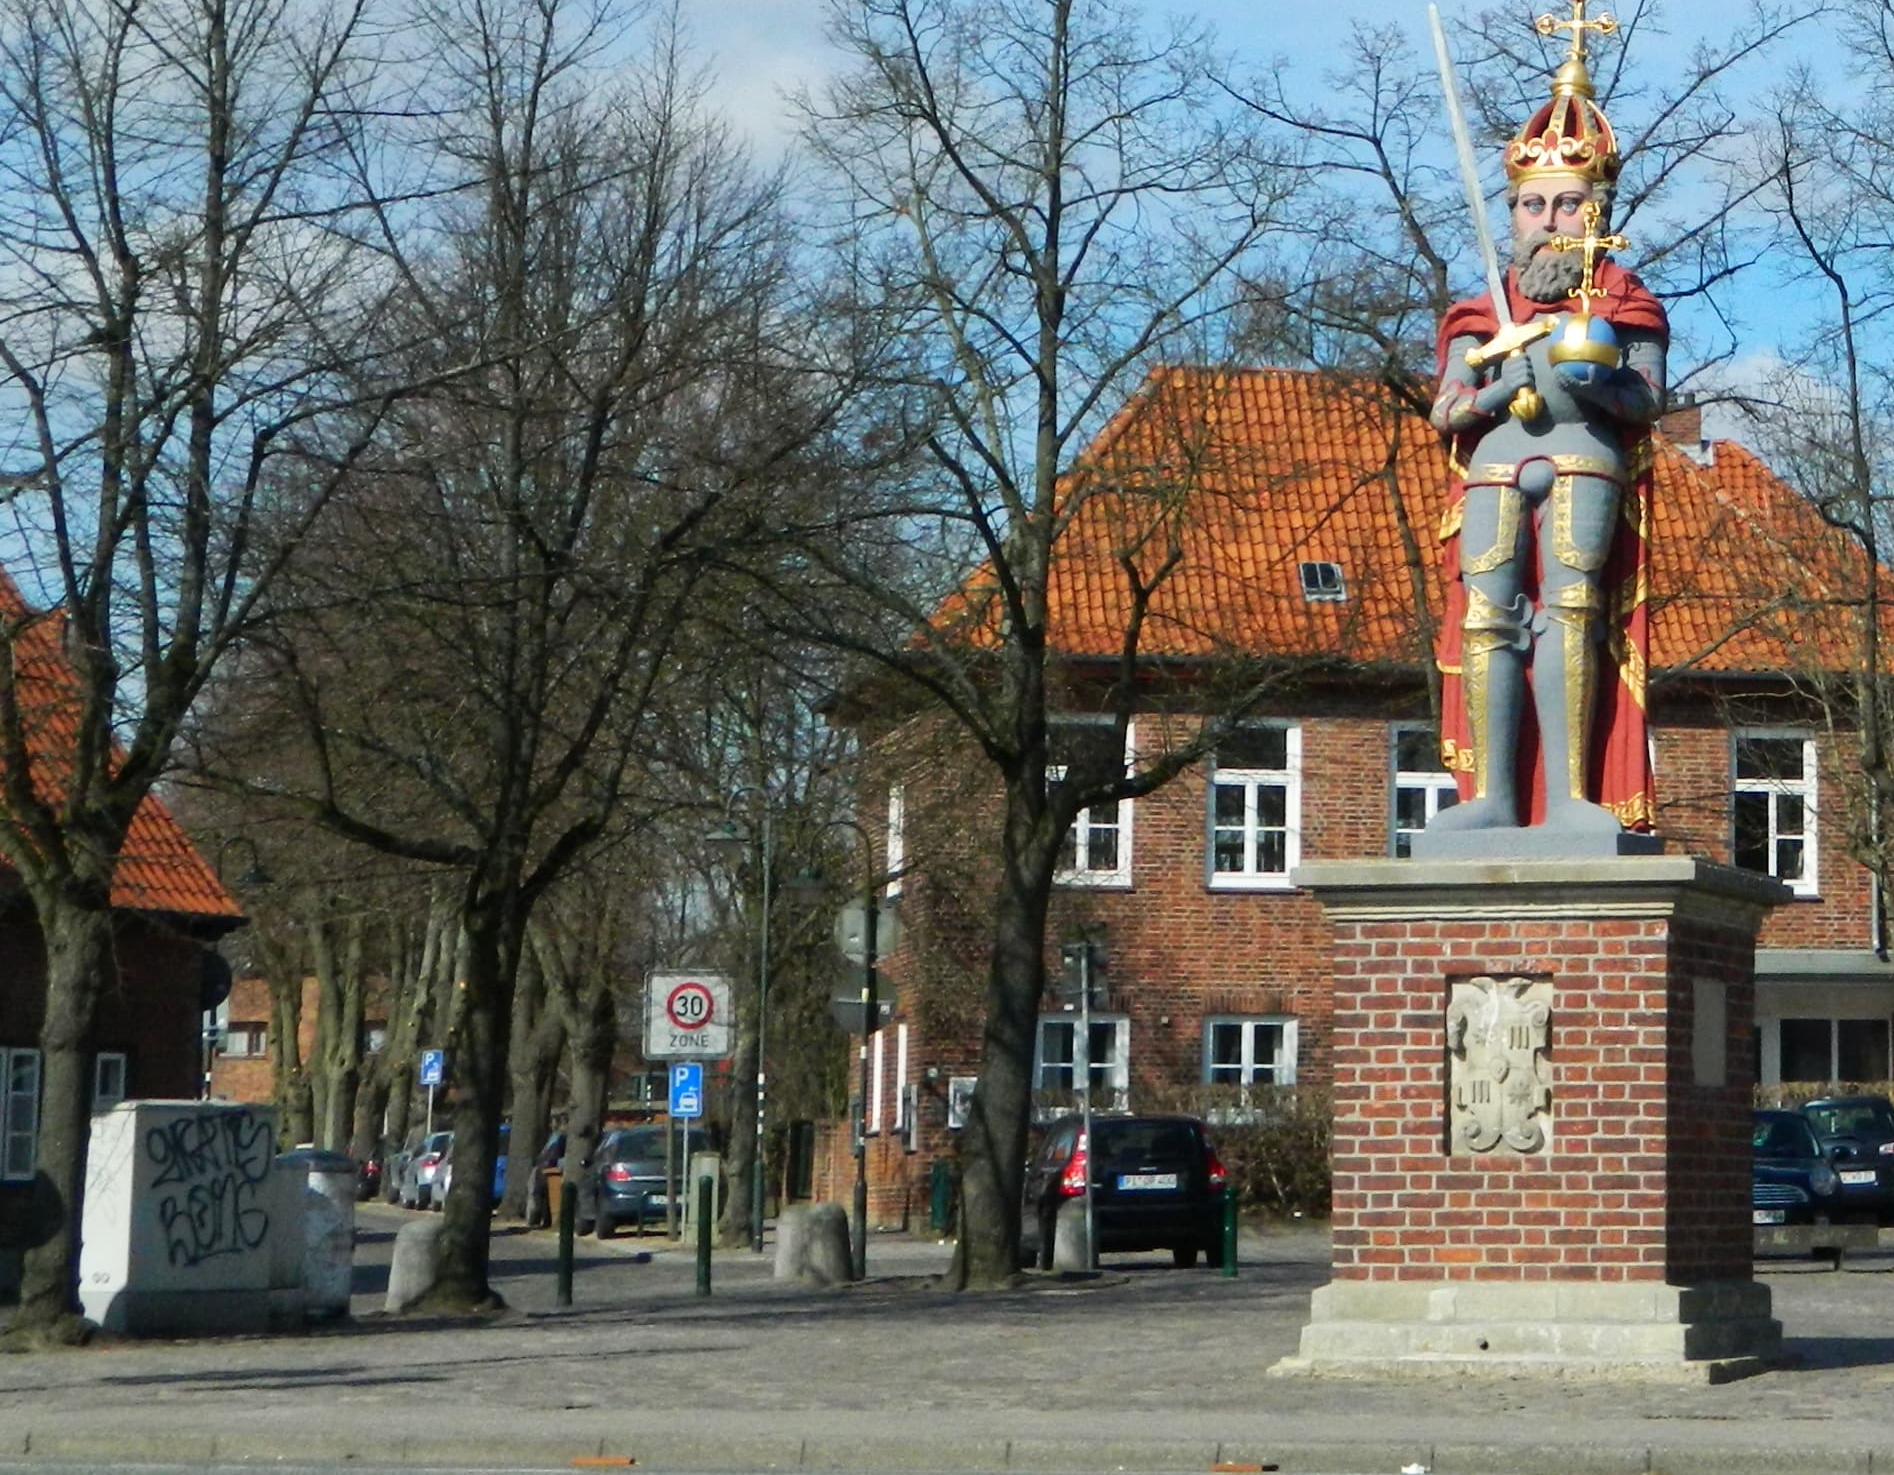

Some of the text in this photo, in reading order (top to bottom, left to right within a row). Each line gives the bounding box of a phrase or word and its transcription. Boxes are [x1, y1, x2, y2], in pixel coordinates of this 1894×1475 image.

[676, 995, 703, 1016] 30
[669, 1034, 709, 1048] ZONE
[425, 1053, 435, 1065] P
[675, 1067, 689, 1087] P
